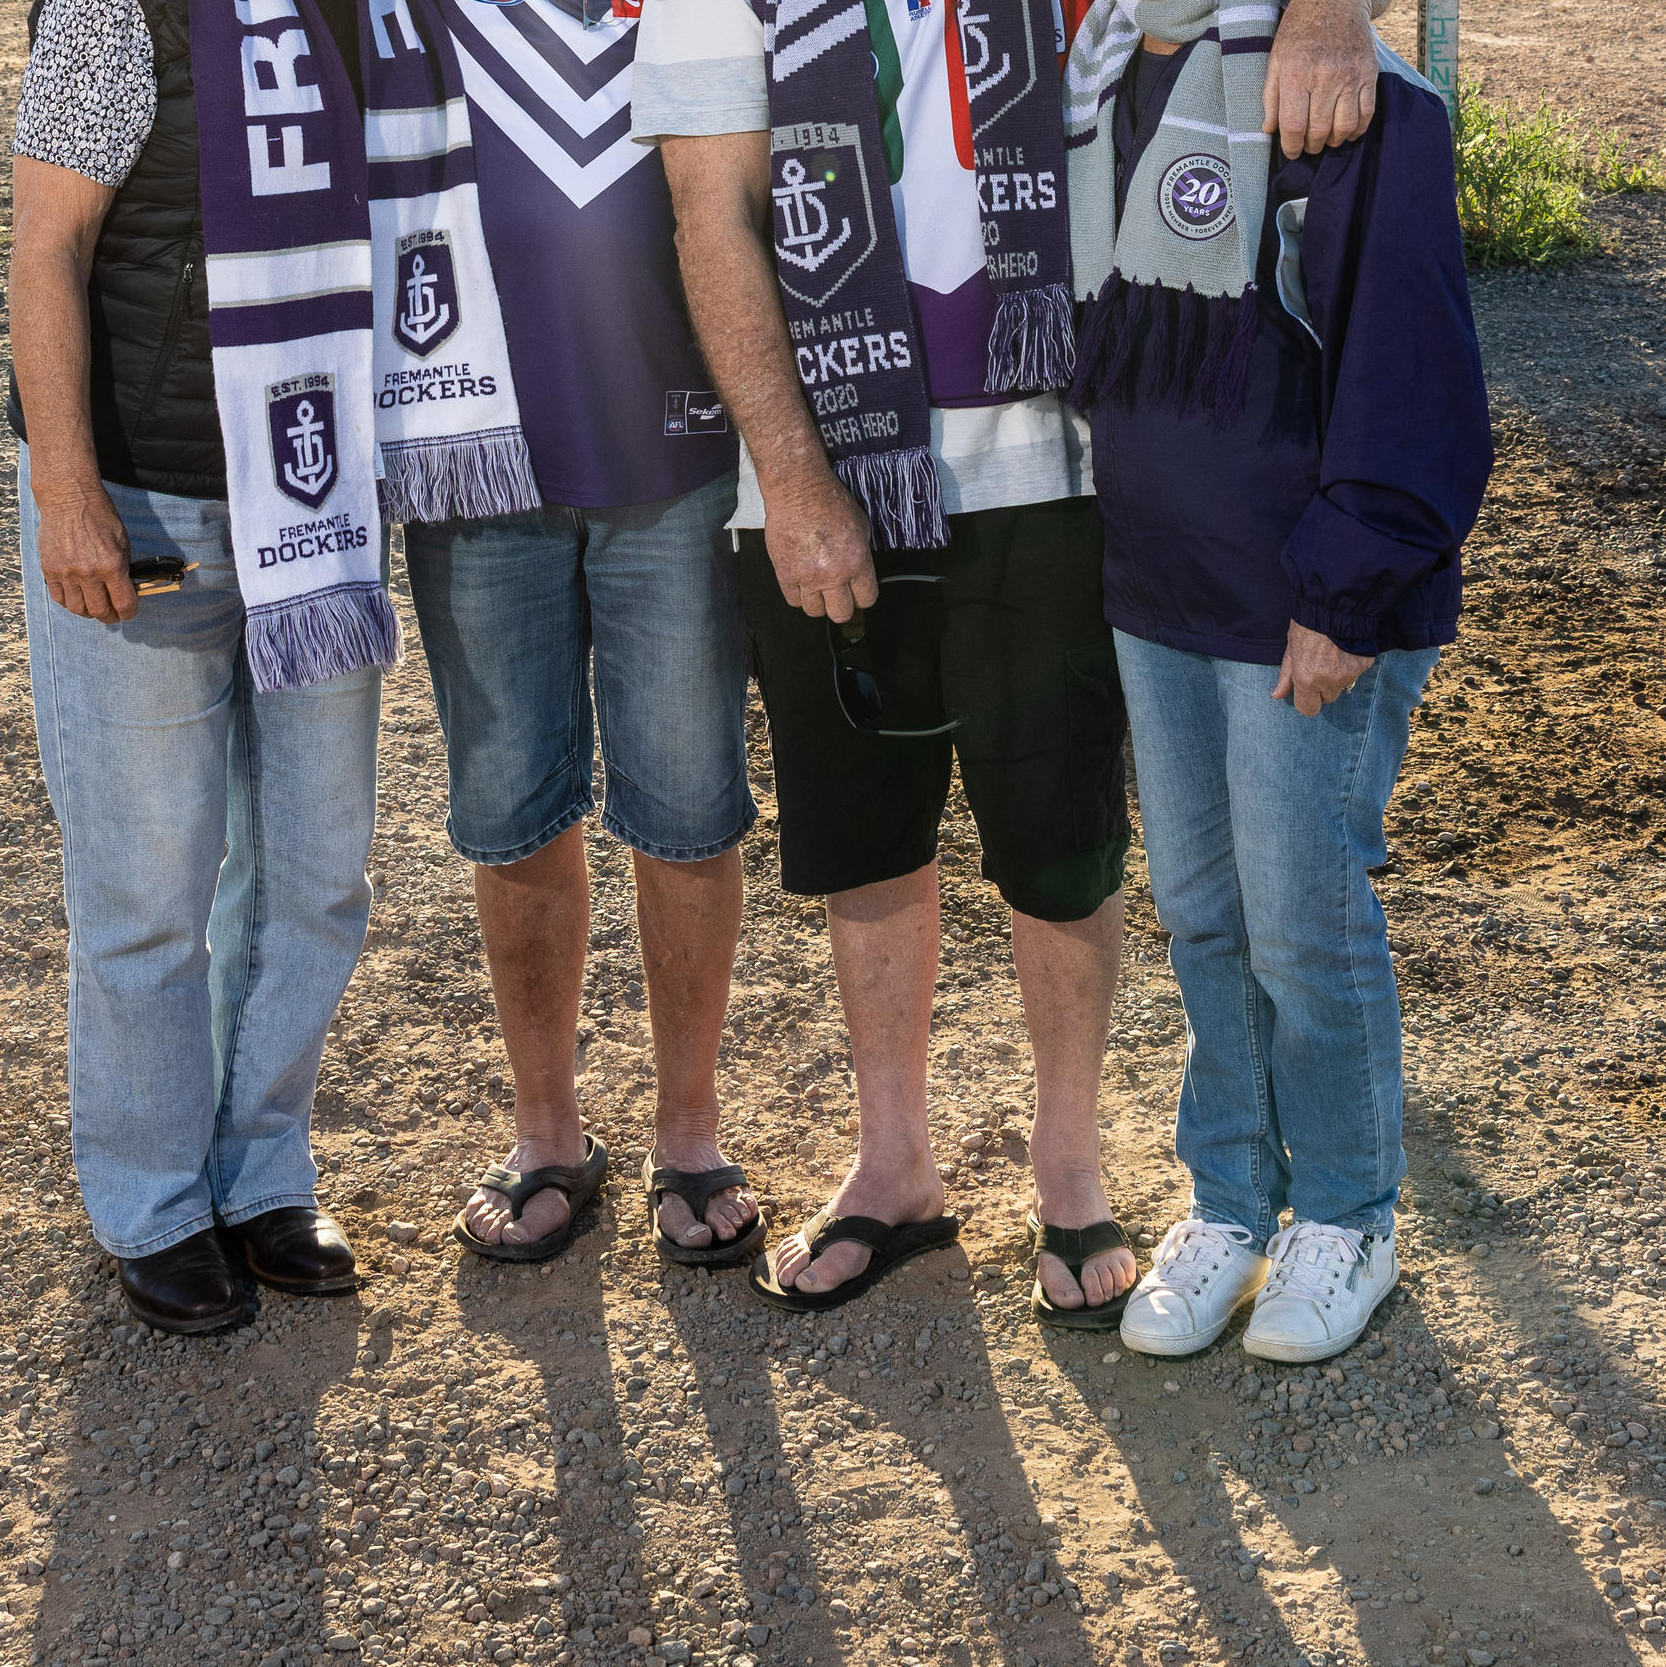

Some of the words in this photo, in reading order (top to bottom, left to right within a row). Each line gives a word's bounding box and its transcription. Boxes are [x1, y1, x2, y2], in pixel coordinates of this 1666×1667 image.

[793, 126, 840, 147] 1994
[973, 146, 1025, 167] ANTLE
[1166, 158, 1211, 187] FREMANTLE
[976, 171, 1057, 213] KERS
[1178, 178, 1221, 206] 20
[1168, 210, 1190, 232] MEMBER
[1183, 205, 1211, 217] YEARS
[1194, 220, 1224, 234] FOREVER
[796, 331, 912, 385] CKERS
[384, 363, 471, 388] FREMANTLE
[373, 375, 498, 410] OCKERS
[812, 382, 860, 416] 2020
[668, 421, 684, 429] AFL
[819, 417, 863, 448] EVER
[859, 410, 900, 440] HERO
[278, 513, 351, 541] FREMANTLE
[257, 525, 368, 569] DOCKERS
